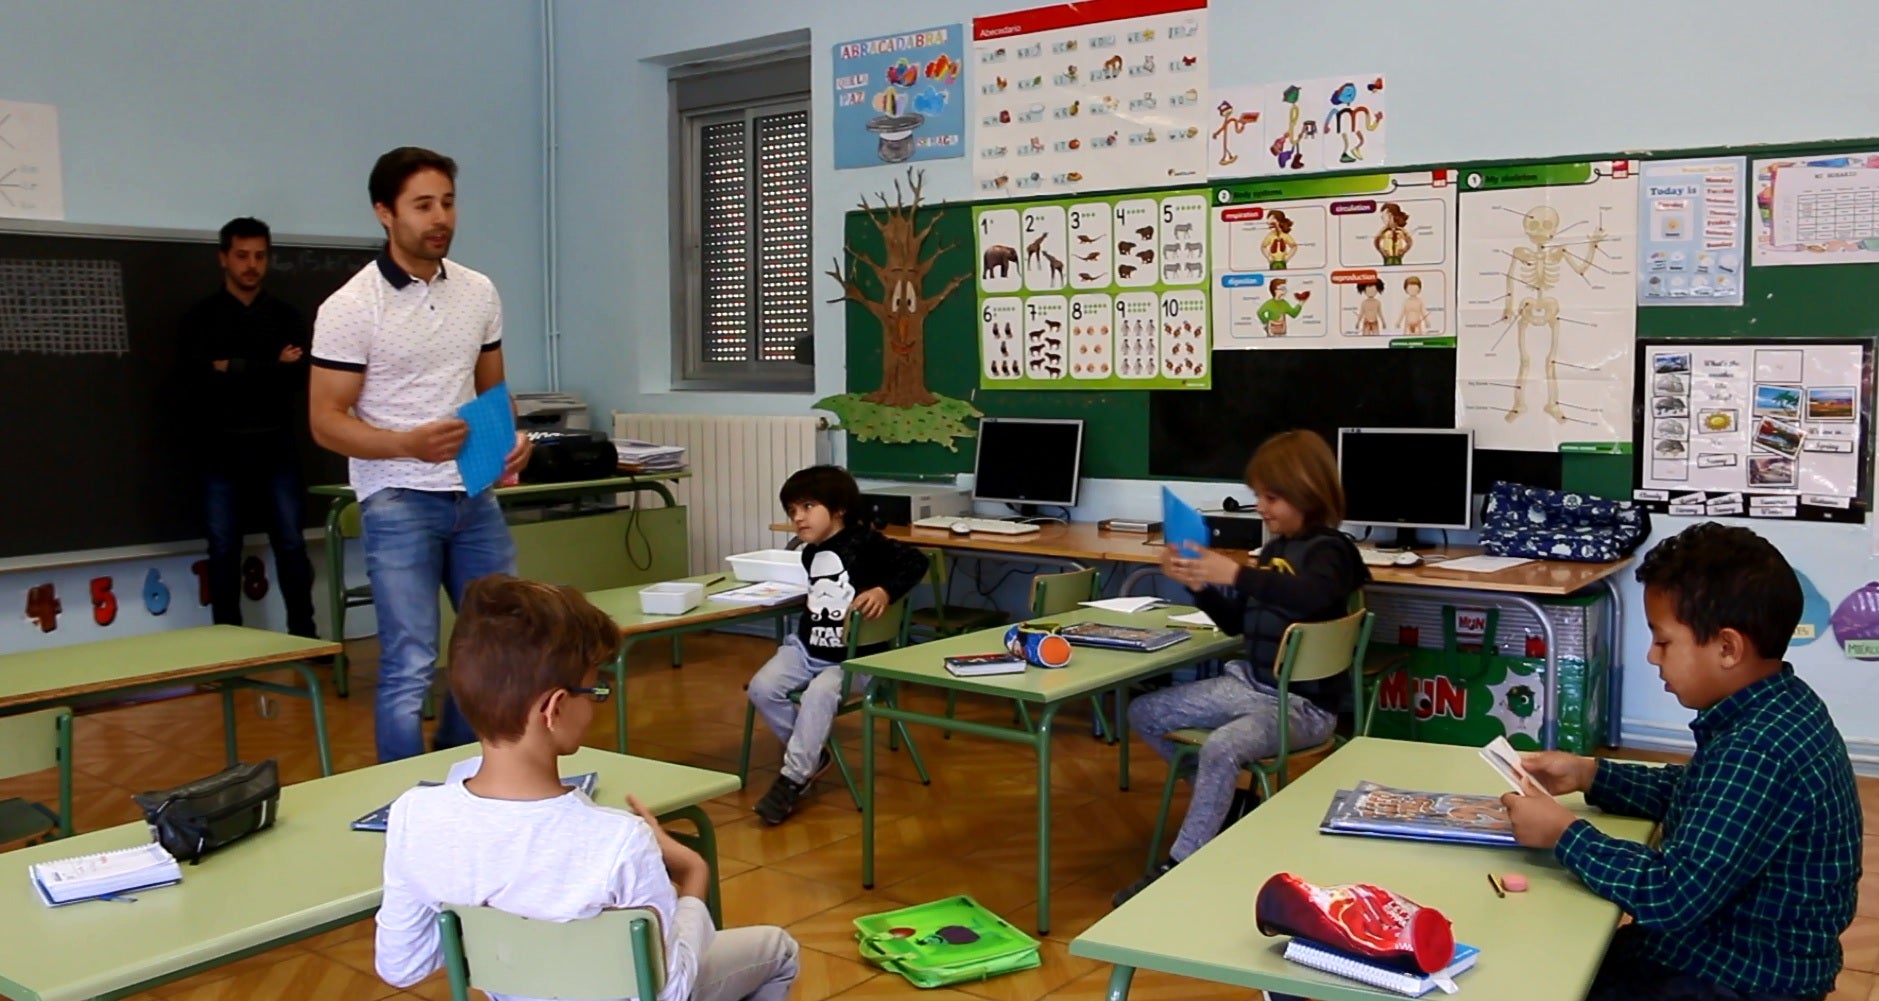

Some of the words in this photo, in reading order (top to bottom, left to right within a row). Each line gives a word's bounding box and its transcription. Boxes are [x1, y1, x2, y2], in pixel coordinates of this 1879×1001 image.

[1650, 187, 1684, 196] Today
[1687, 186, 1697, 194] is
[1071, 211, 1080, 229] 3
[1116, 208, 1125, 226] 4
[1163, 204, 1173, 223] 5
[981, 218, 988, 235] 1
[1025, 214, 1035, 232] 2
[983, 305, 992, 322] 6
[1027, 304, 1037, 321] 7
[1072, 302, 1082, 320] 8
[1116, 300, 1125, 318] 9
[1162, 299, 1179, 317] 10
[242, 556, 269, 601] 8
[143, 567, 171, 616] 6
[26, 582, 62, 633] 4
[90, 576, 118, 626] 5
[809, 636, 845, 648] WAR
